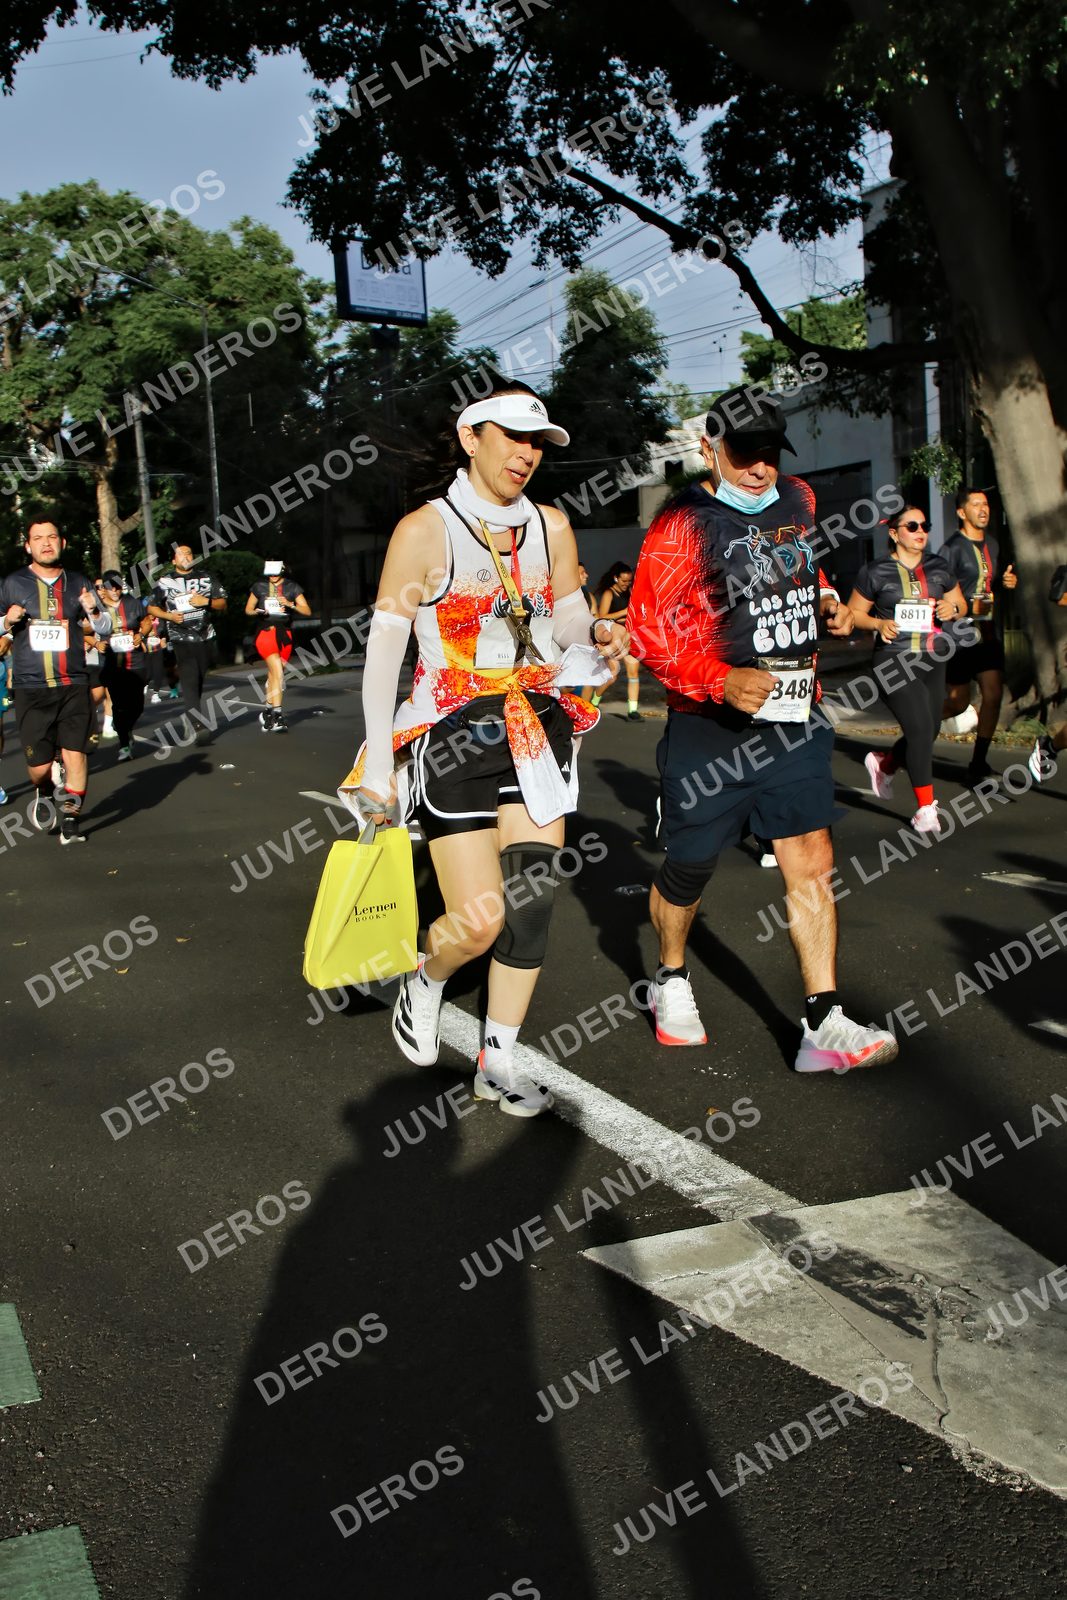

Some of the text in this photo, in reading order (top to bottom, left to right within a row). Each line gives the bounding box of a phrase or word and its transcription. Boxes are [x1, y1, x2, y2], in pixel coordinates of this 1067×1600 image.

[749, 585, 815, 616] LOS QUE
[757, 604, 814, 629] HACEMOS
[900, 609, 926, 620] 8811
[35, 629, 60, 640] 7957
[753, 615, 817, 653] BOLA
[353, 902, 397, 916] Lernen
[355, 913, 387, 923] BOOKS
